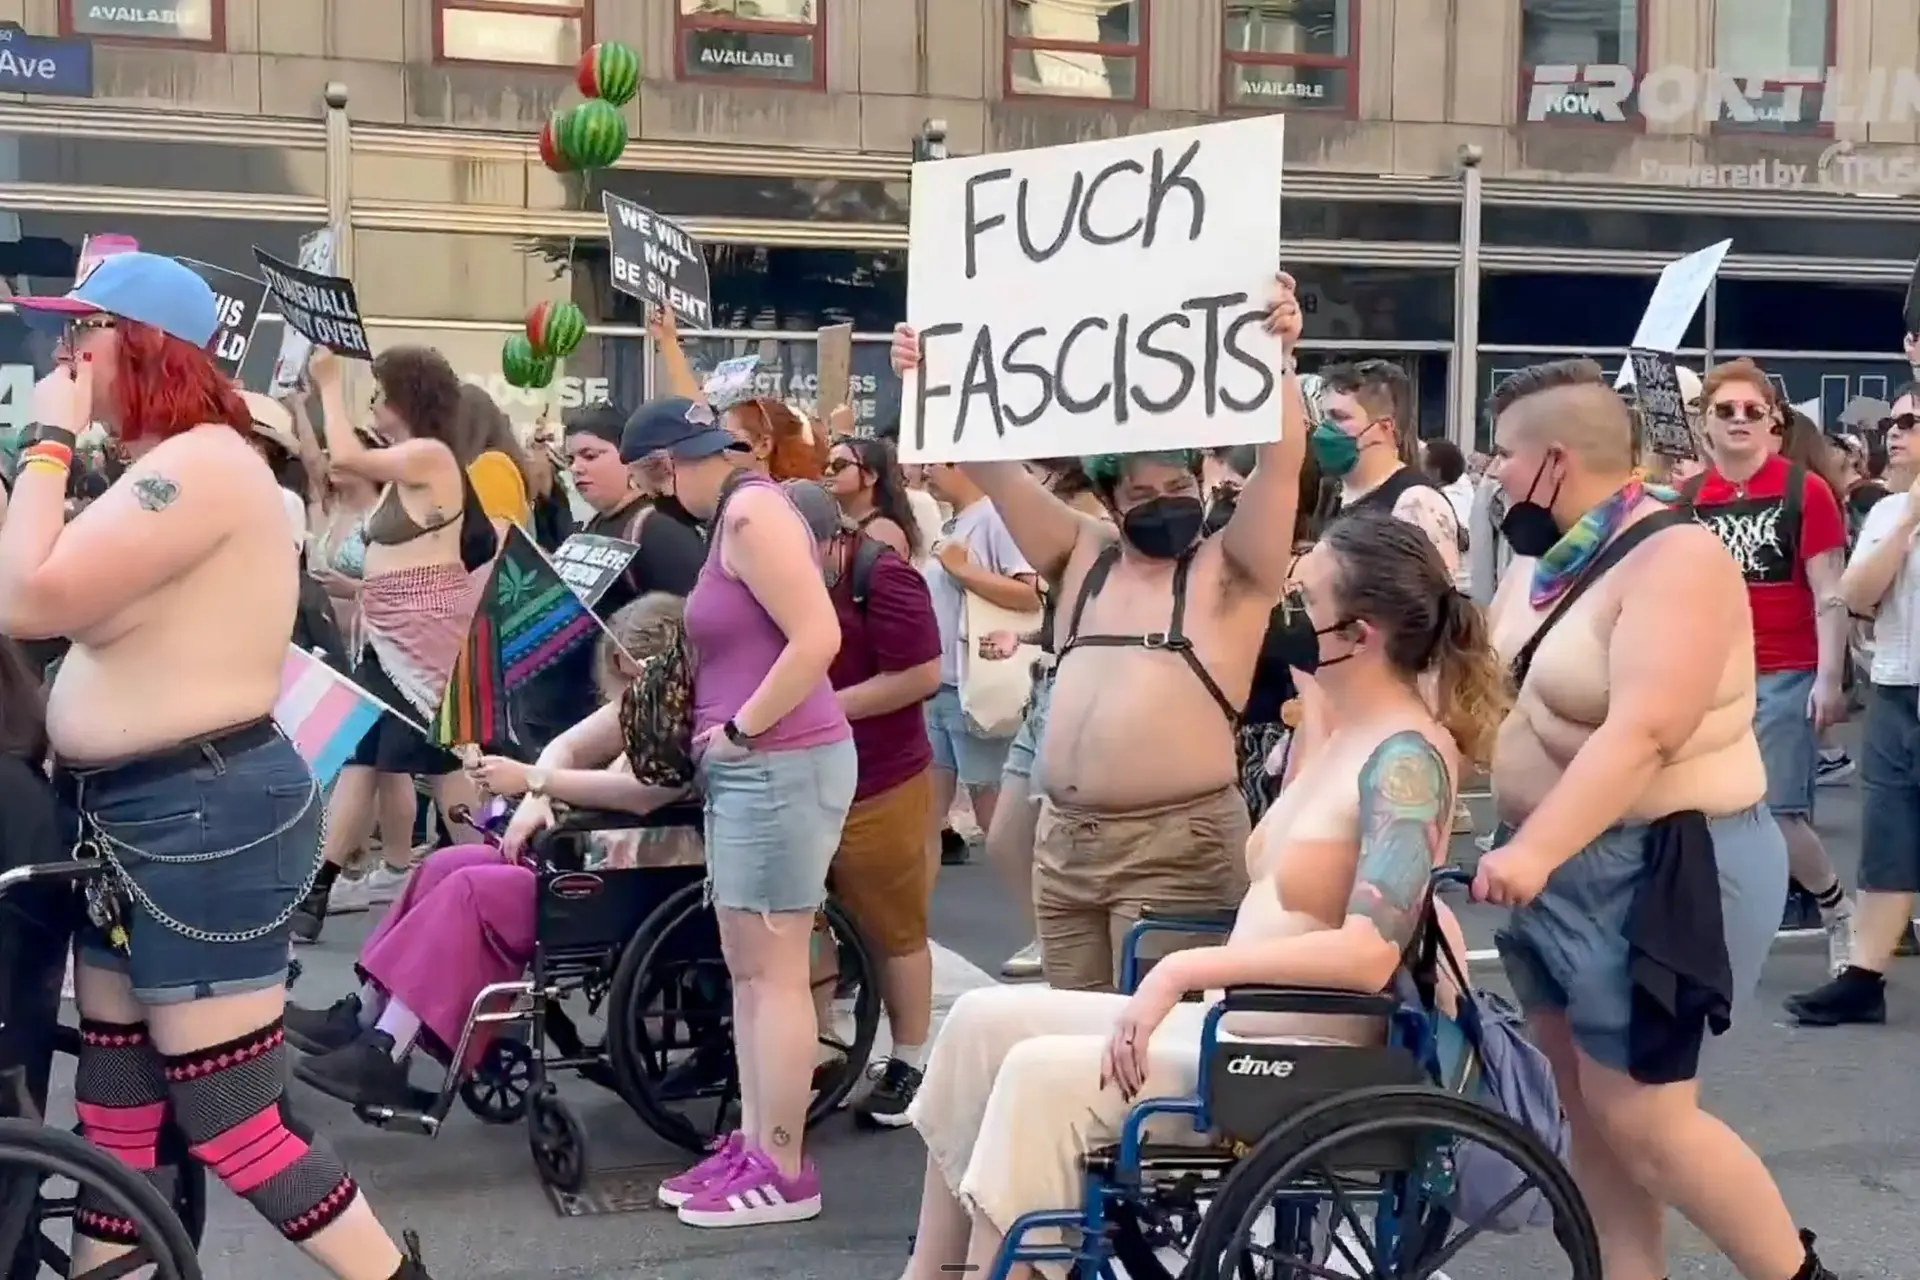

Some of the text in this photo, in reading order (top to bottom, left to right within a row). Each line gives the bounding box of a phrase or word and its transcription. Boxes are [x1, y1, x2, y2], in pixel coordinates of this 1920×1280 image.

[0, 49, 57, 79] Ave
[701, 47, 794, 67] AVAILABLE
[1241, 80, 1324, 98] AVAILABLE
[965, 140, 1206, 279] FUCK
[616, 203, 699, 264] WE WILL
[643, 240, 680, 279] NOT
[614, 255, 707, 321] BE SILENT
[916, 292, 1274, 450] FASCISTS
[1227, 1054, 1294, 1077] drive
